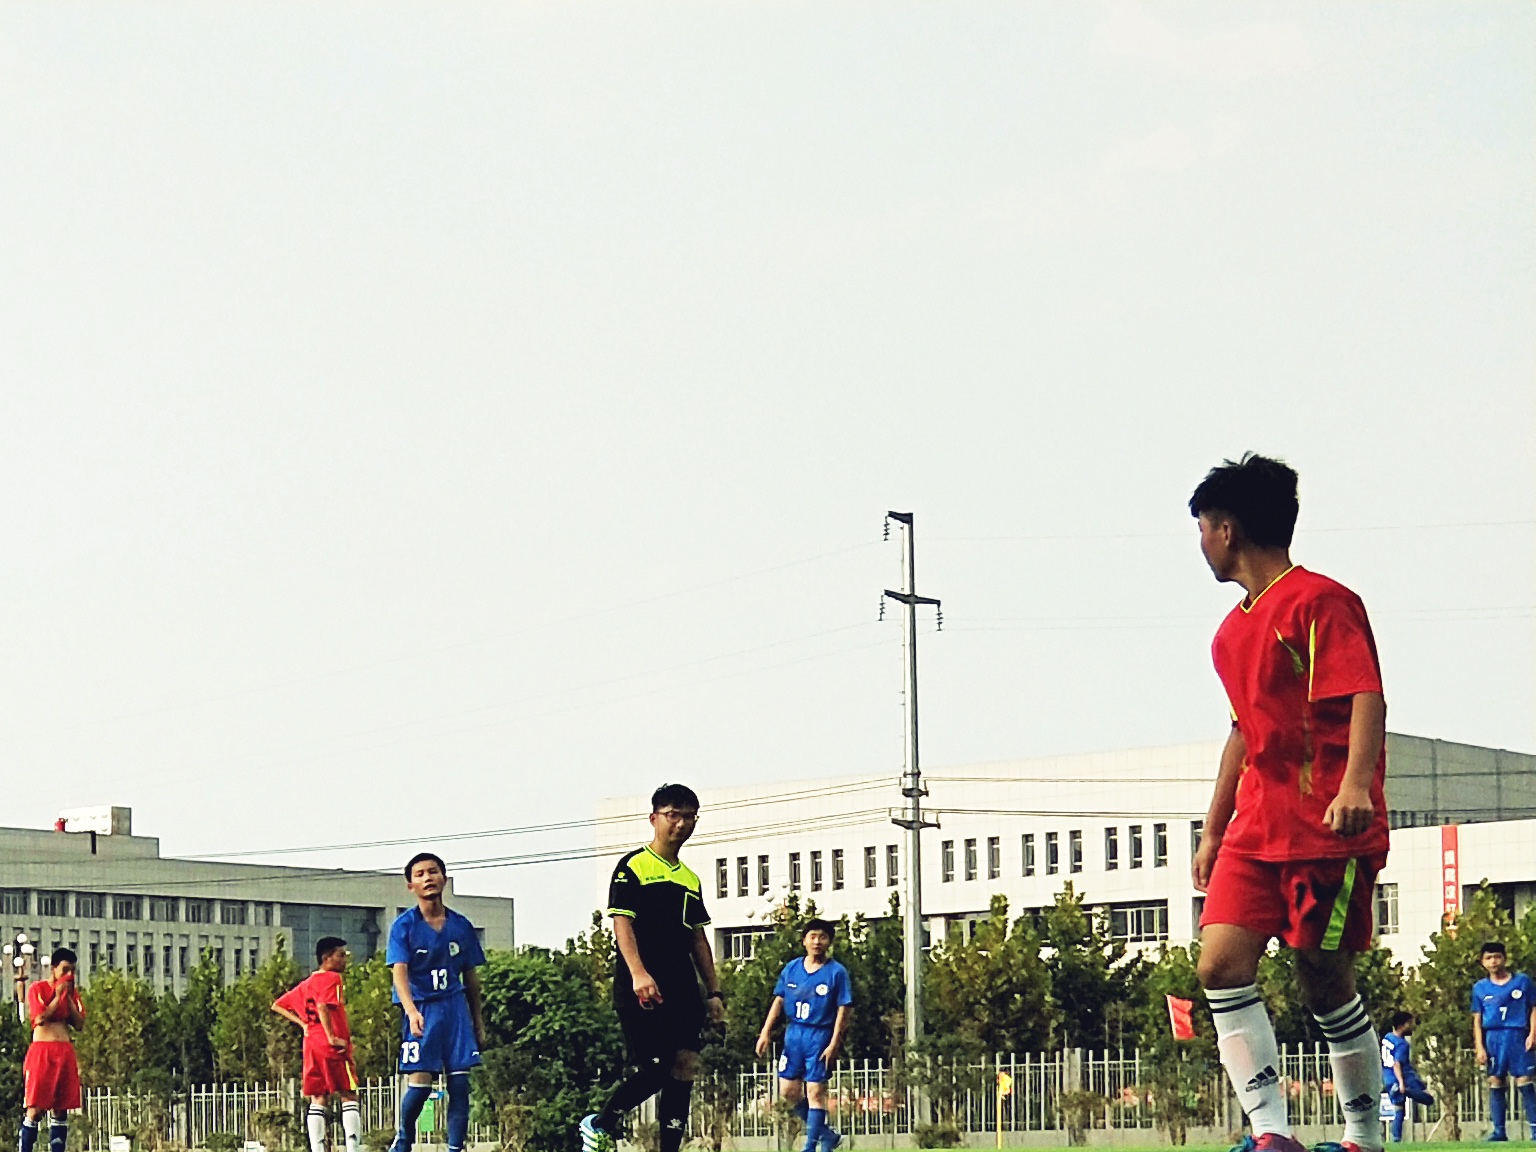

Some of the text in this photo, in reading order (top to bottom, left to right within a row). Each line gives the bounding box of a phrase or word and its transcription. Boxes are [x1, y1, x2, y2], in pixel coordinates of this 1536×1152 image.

[431, 968, 448, 990] 13
[796, 1001, 810, 1020] 18
[1499, 1006, 1507, 1020] 7
[401, 1041, 420, 1064] 13
